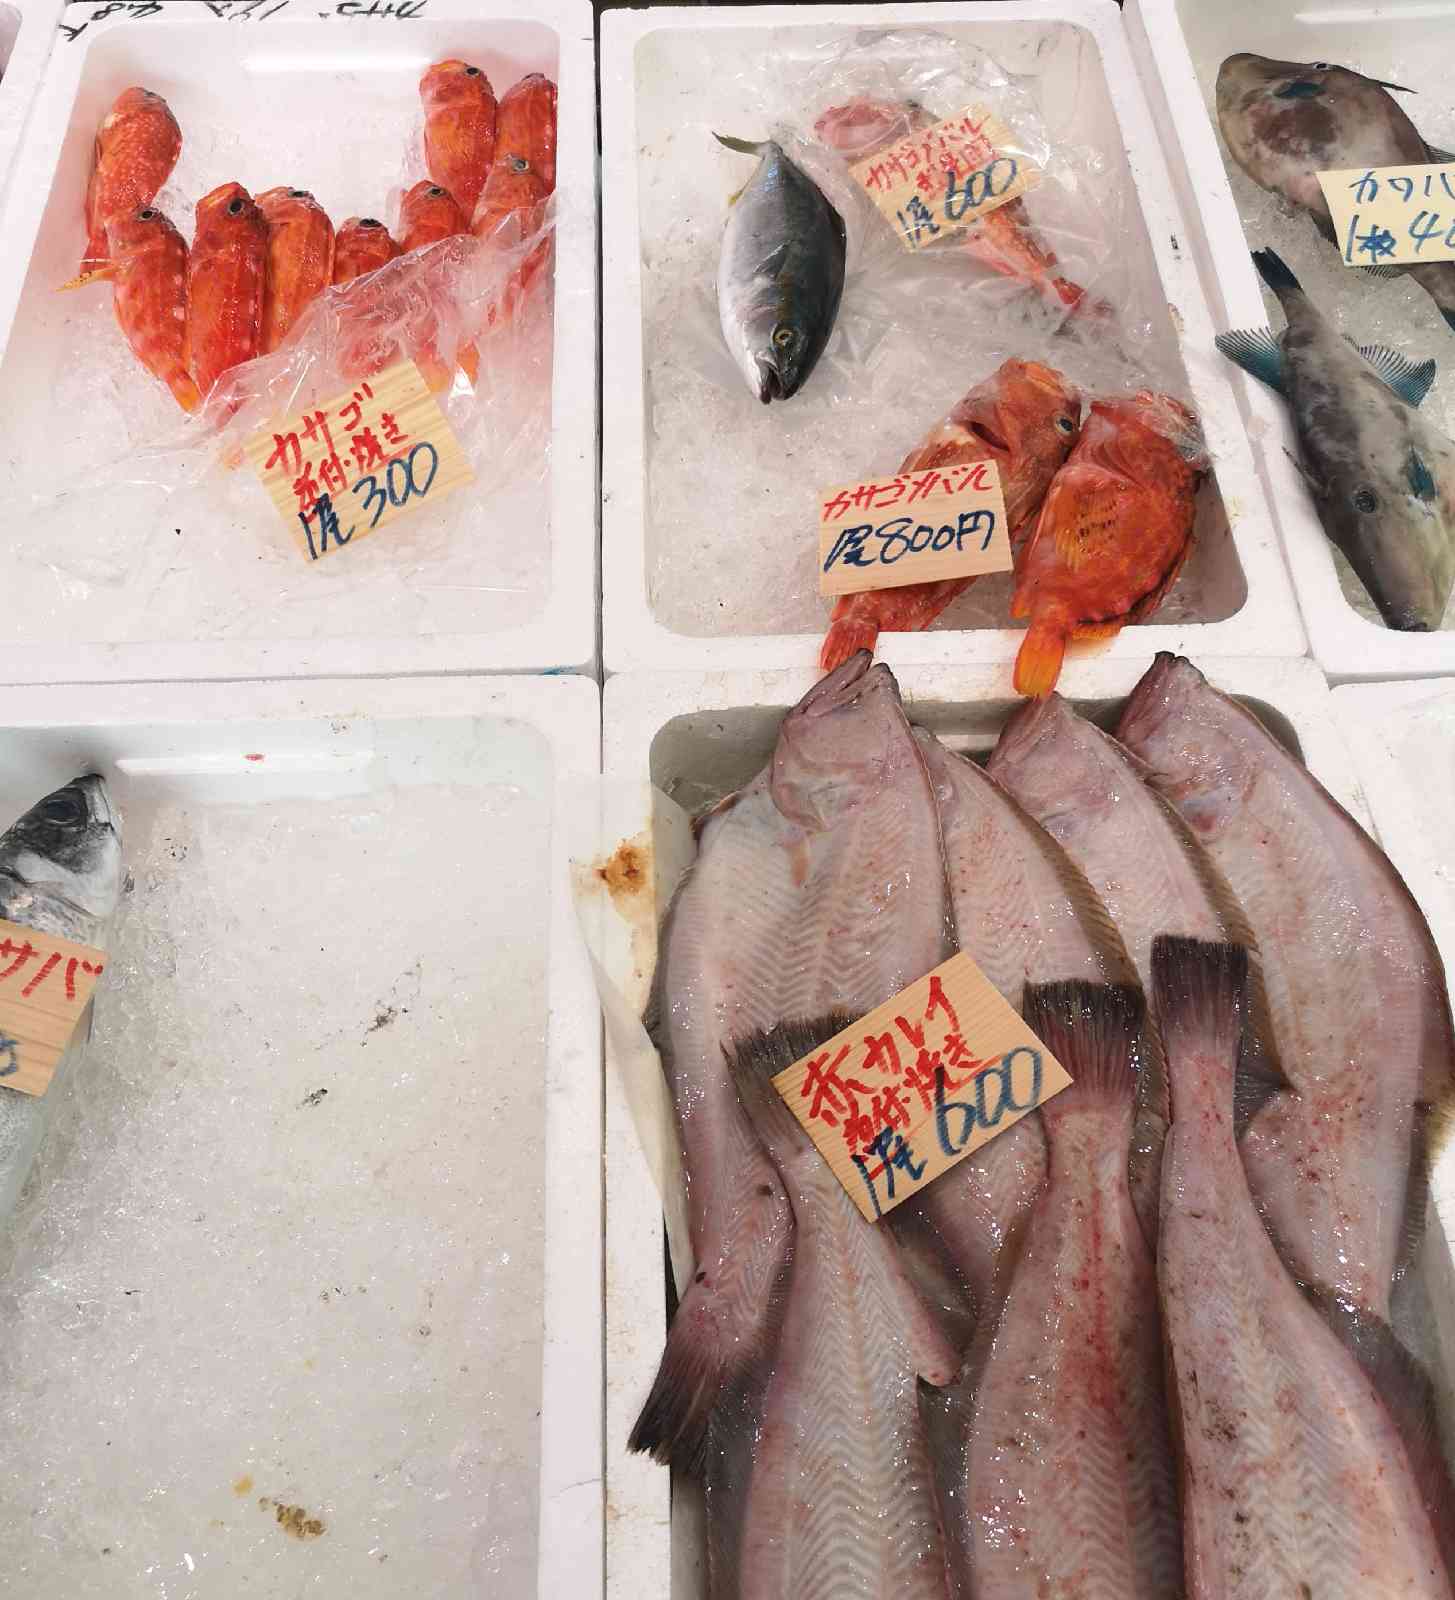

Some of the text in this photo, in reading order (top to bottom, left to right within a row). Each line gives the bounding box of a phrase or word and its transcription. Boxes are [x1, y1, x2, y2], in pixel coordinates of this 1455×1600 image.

[265, 382, 374, 473] カサゴ
[352, 441, 438, 528] 300
[801, 975, 960, 1128] 赤カレイ
[934, 1046, 1043, 1156] 600
